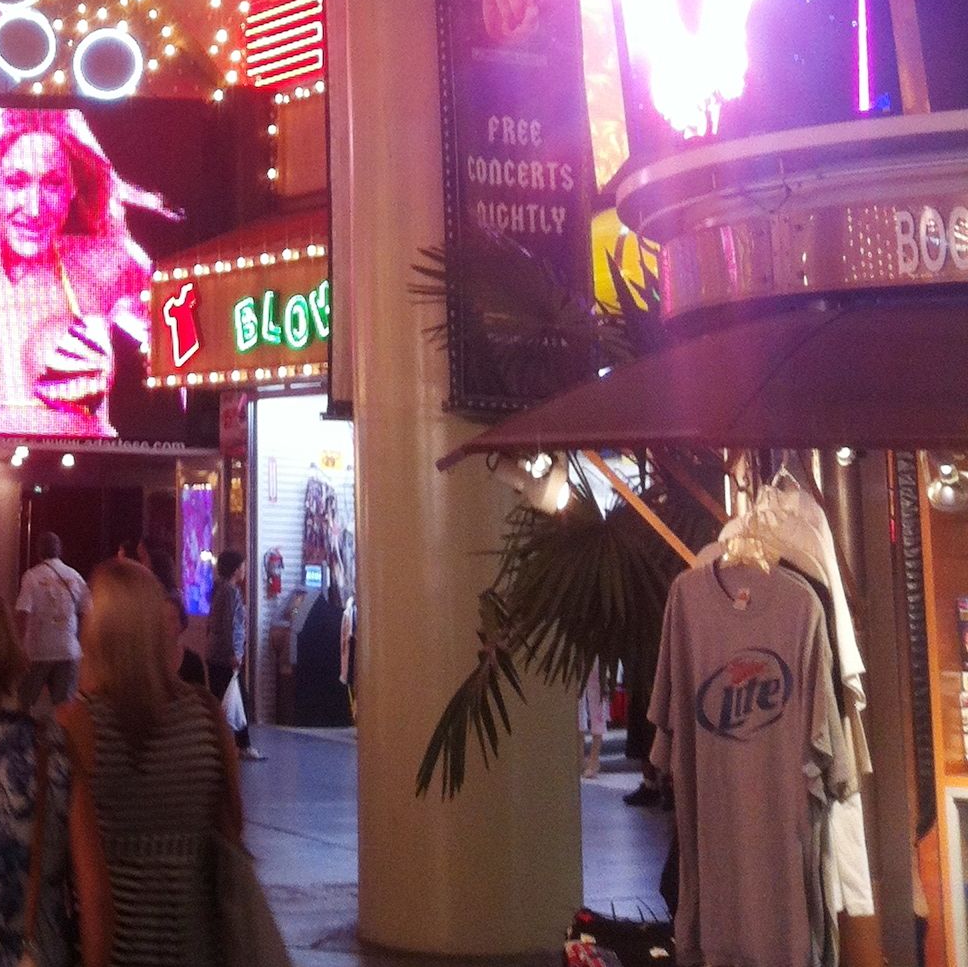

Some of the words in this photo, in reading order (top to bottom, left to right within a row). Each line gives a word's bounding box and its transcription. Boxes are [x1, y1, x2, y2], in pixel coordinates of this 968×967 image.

[467, 155, 574, 191] CONCERTS
[477, 199, 566, 235] NIGHTLY
[718, 676, 781, 730] Lite
